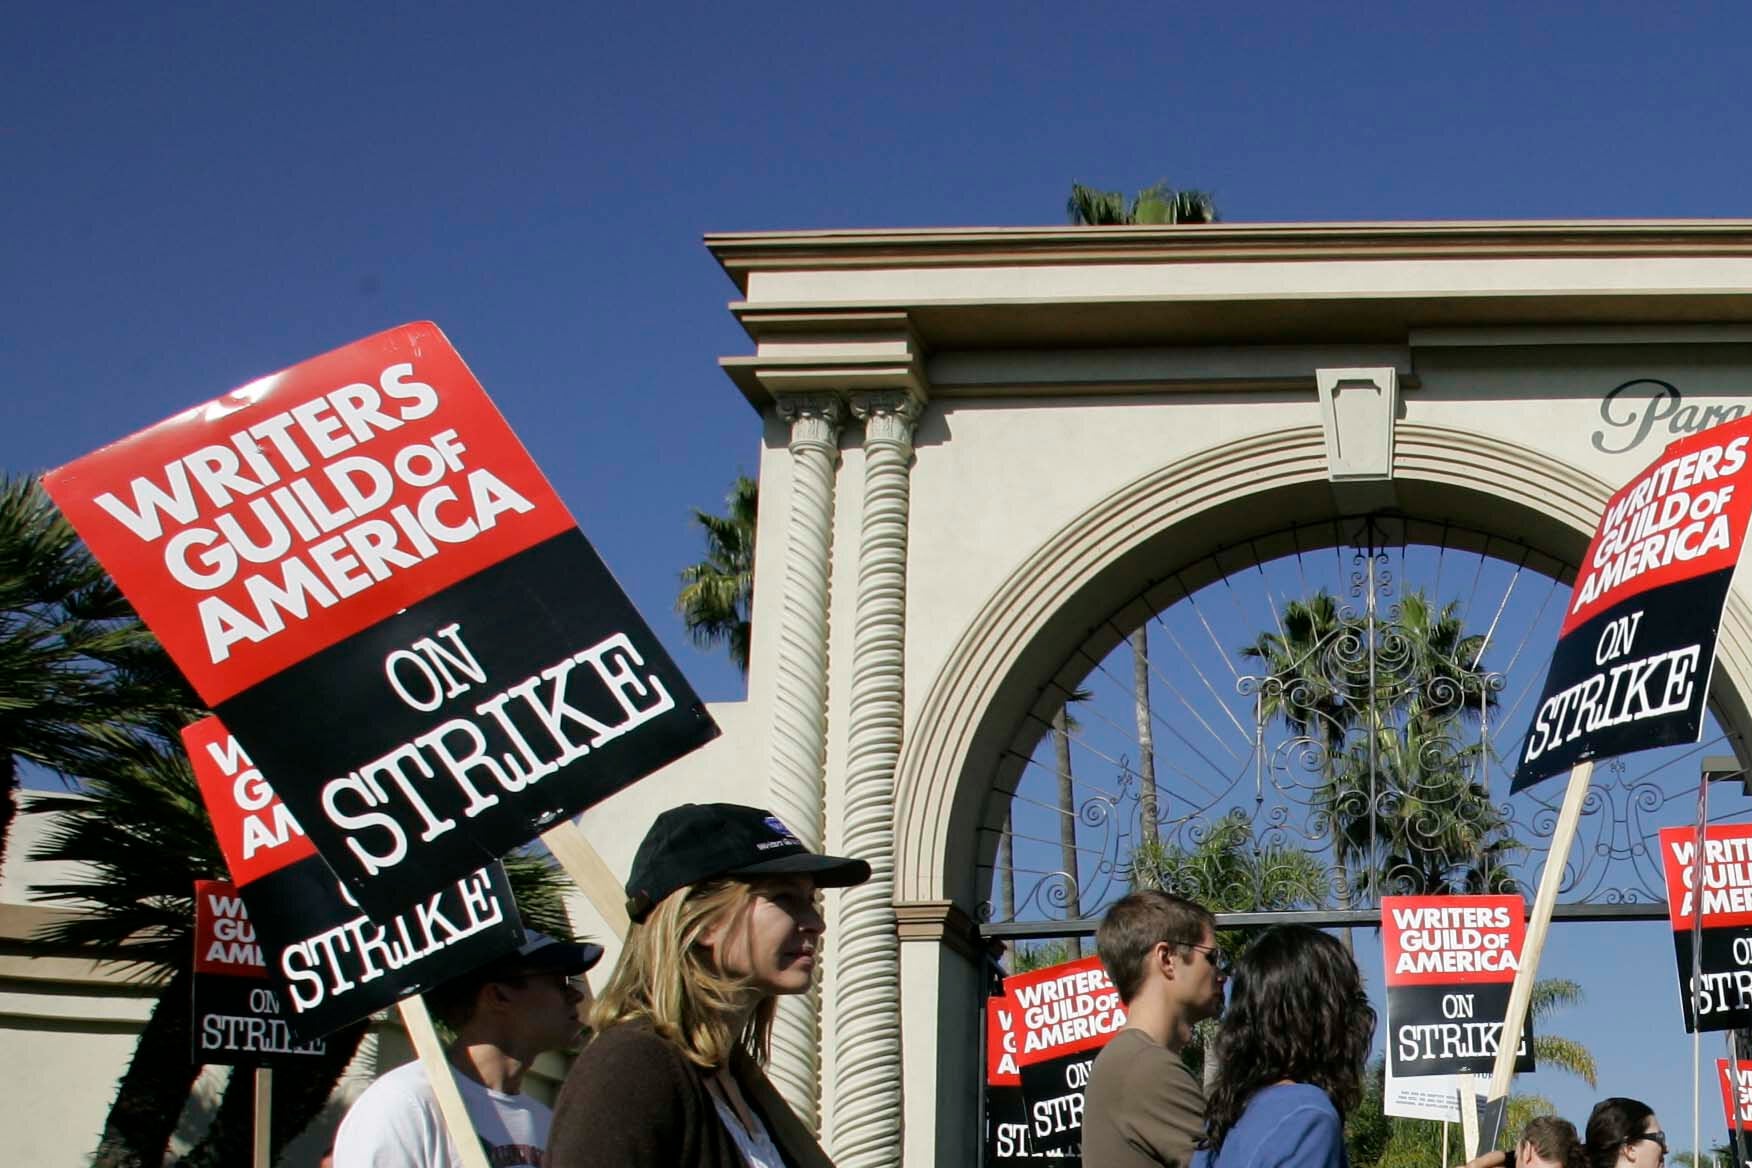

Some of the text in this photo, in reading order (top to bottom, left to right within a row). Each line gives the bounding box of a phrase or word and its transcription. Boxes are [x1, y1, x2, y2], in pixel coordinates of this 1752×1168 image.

[95, 362, 440, 543] WRITERS
[1601, 435, 1748, 535] WRITERS
[163, 429, 467, 592] GUILD OF
[1592, 485, 1734, 570] GUILD OF
[195, 467, 535, 665] AMERICA
[1572, 514, 1731, 615] AMERICA
[384, 622, 487, 713] ON
[1596, 611, 1643, 667] ON
[1524, 645, 1701, 765] STRIKE
[320, 631, 676, 877] STRIKE
[281, 867, 504, 1014] STRIKE
[1392, 907, 1511, 929] WRITERS
[1395, 951, 1521, 974] AMERICA
[1400, 929, 1510, 951] GUILD OF
[1024, 994, 1095, 1030] GUILD
[1095, 992, 1120, 1012] OF
[1024, 1008, 1128, 1054] AMERICA
[1442, 994, 1474, 1019] ON
